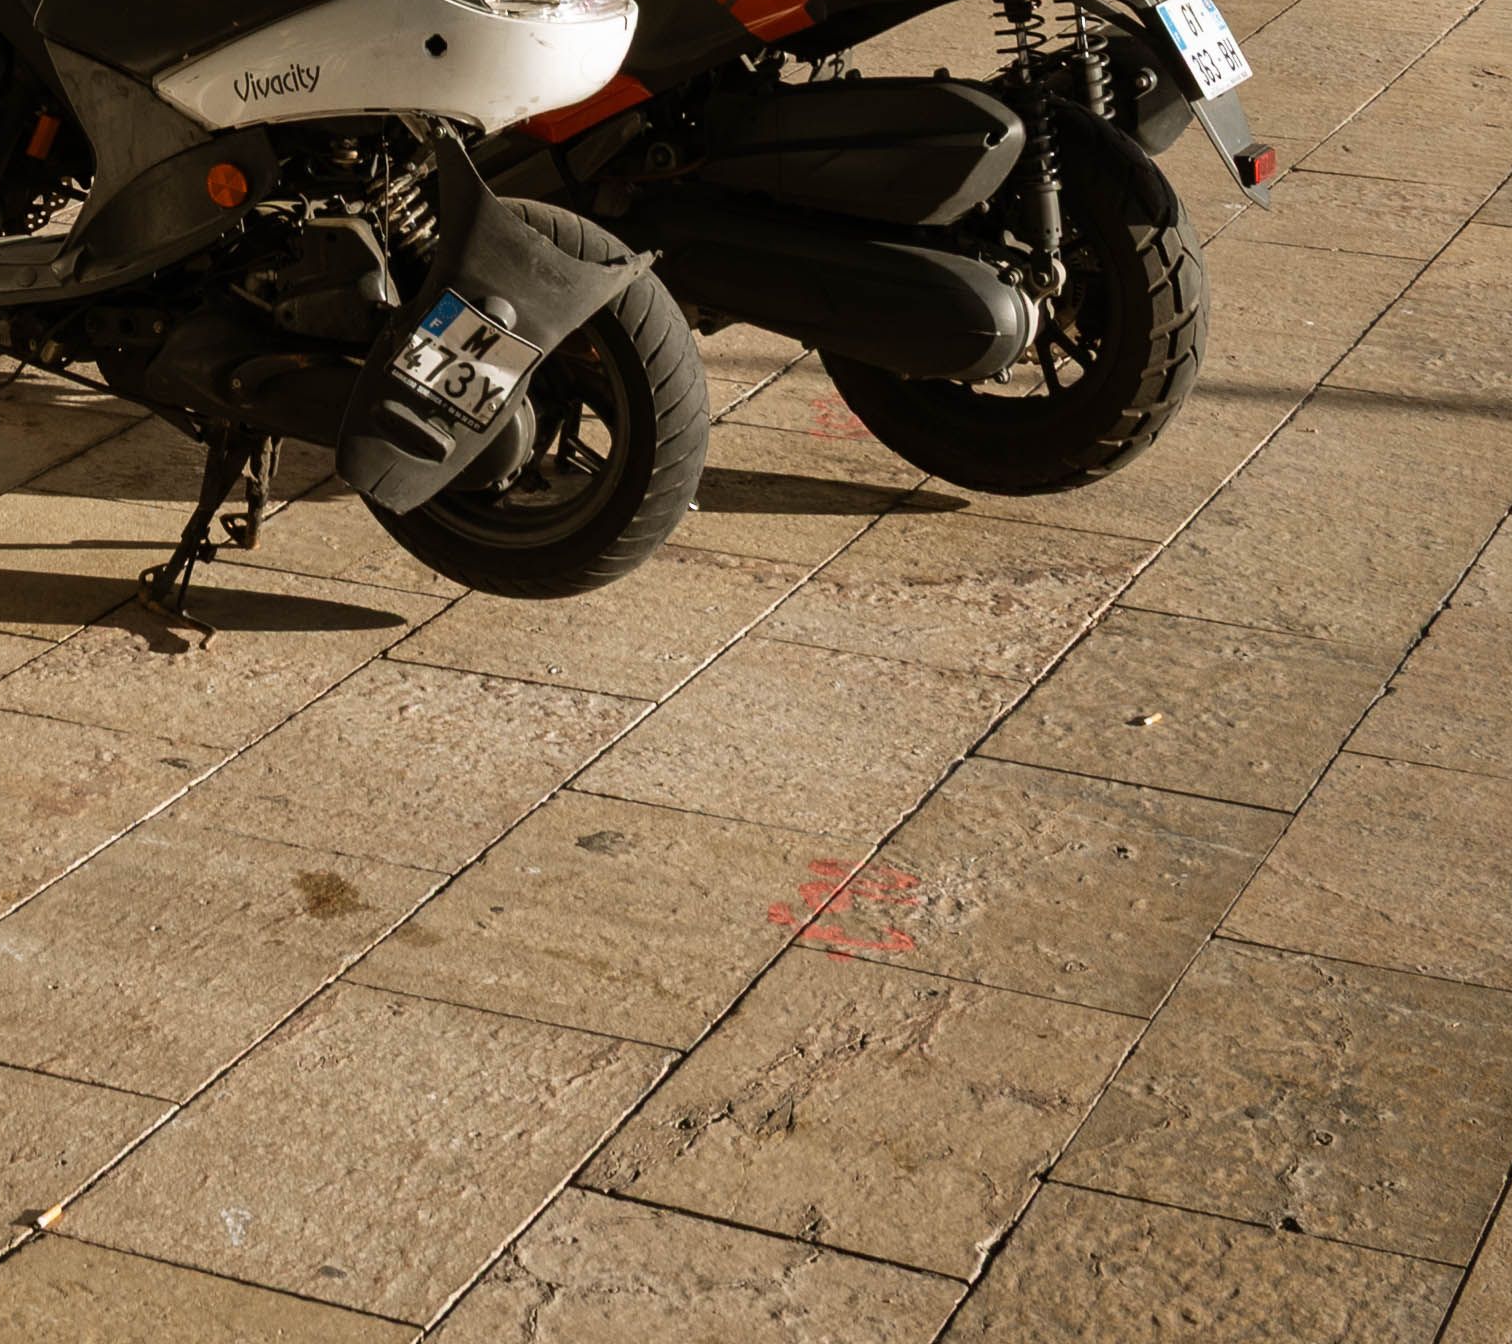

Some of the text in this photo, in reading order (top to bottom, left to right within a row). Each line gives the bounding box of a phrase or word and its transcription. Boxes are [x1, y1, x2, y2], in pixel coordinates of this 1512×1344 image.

[1191, 37, 1243, 87] 363-BH
[233, 63, 321, 103] Vivacity
[461, 324, 502, 361] M
